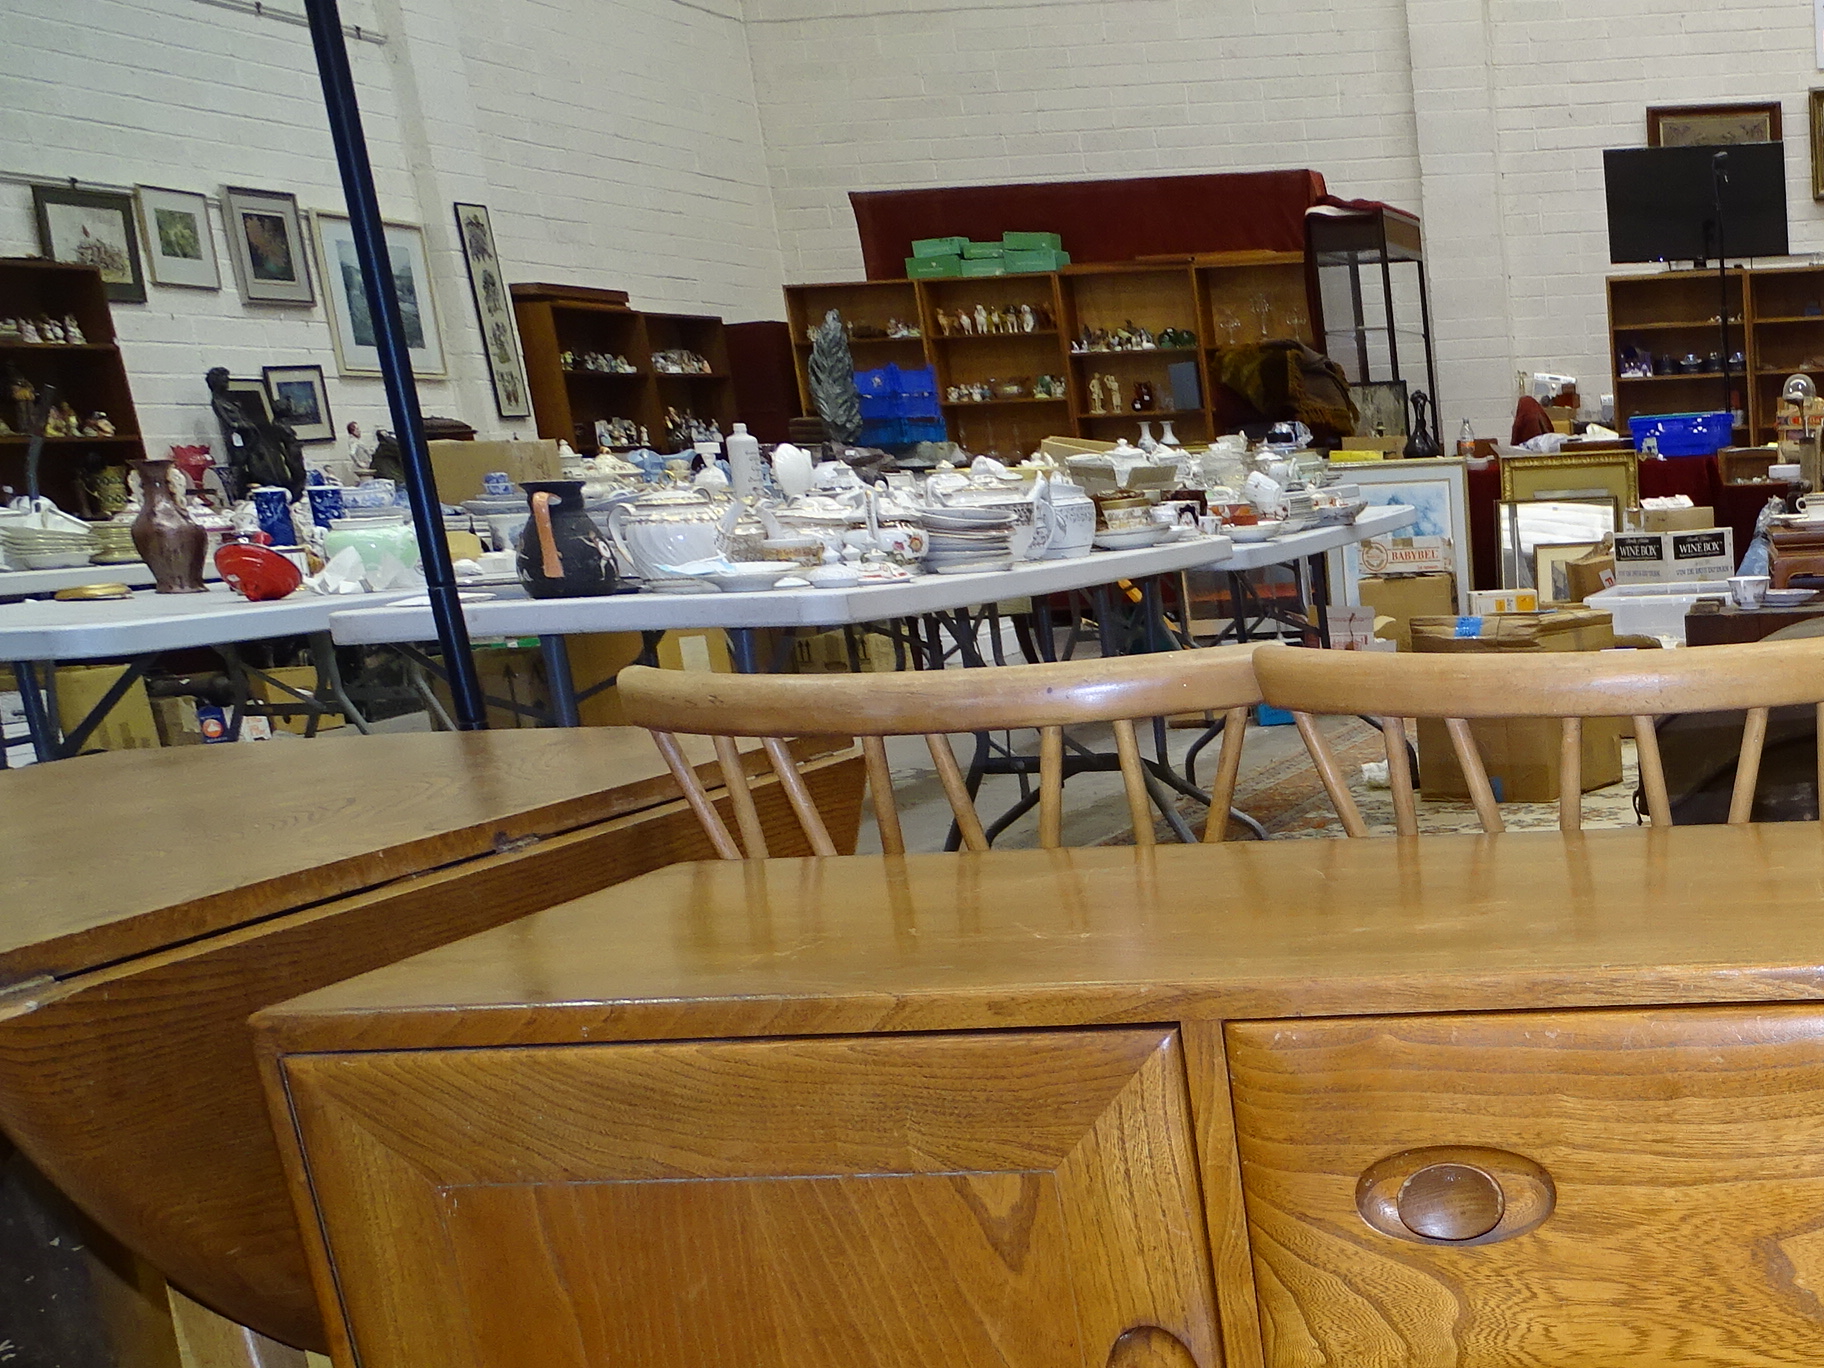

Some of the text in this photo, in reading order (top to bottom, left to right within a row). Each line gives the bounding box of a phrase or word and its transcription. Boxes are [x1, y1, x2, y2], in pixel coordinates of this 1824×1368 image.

[1619, 544, 1640, 557] WINE
[1679, 540, 1720, 554] WINE BOX
[1391, 549, 1438, 561] BABYBEL
